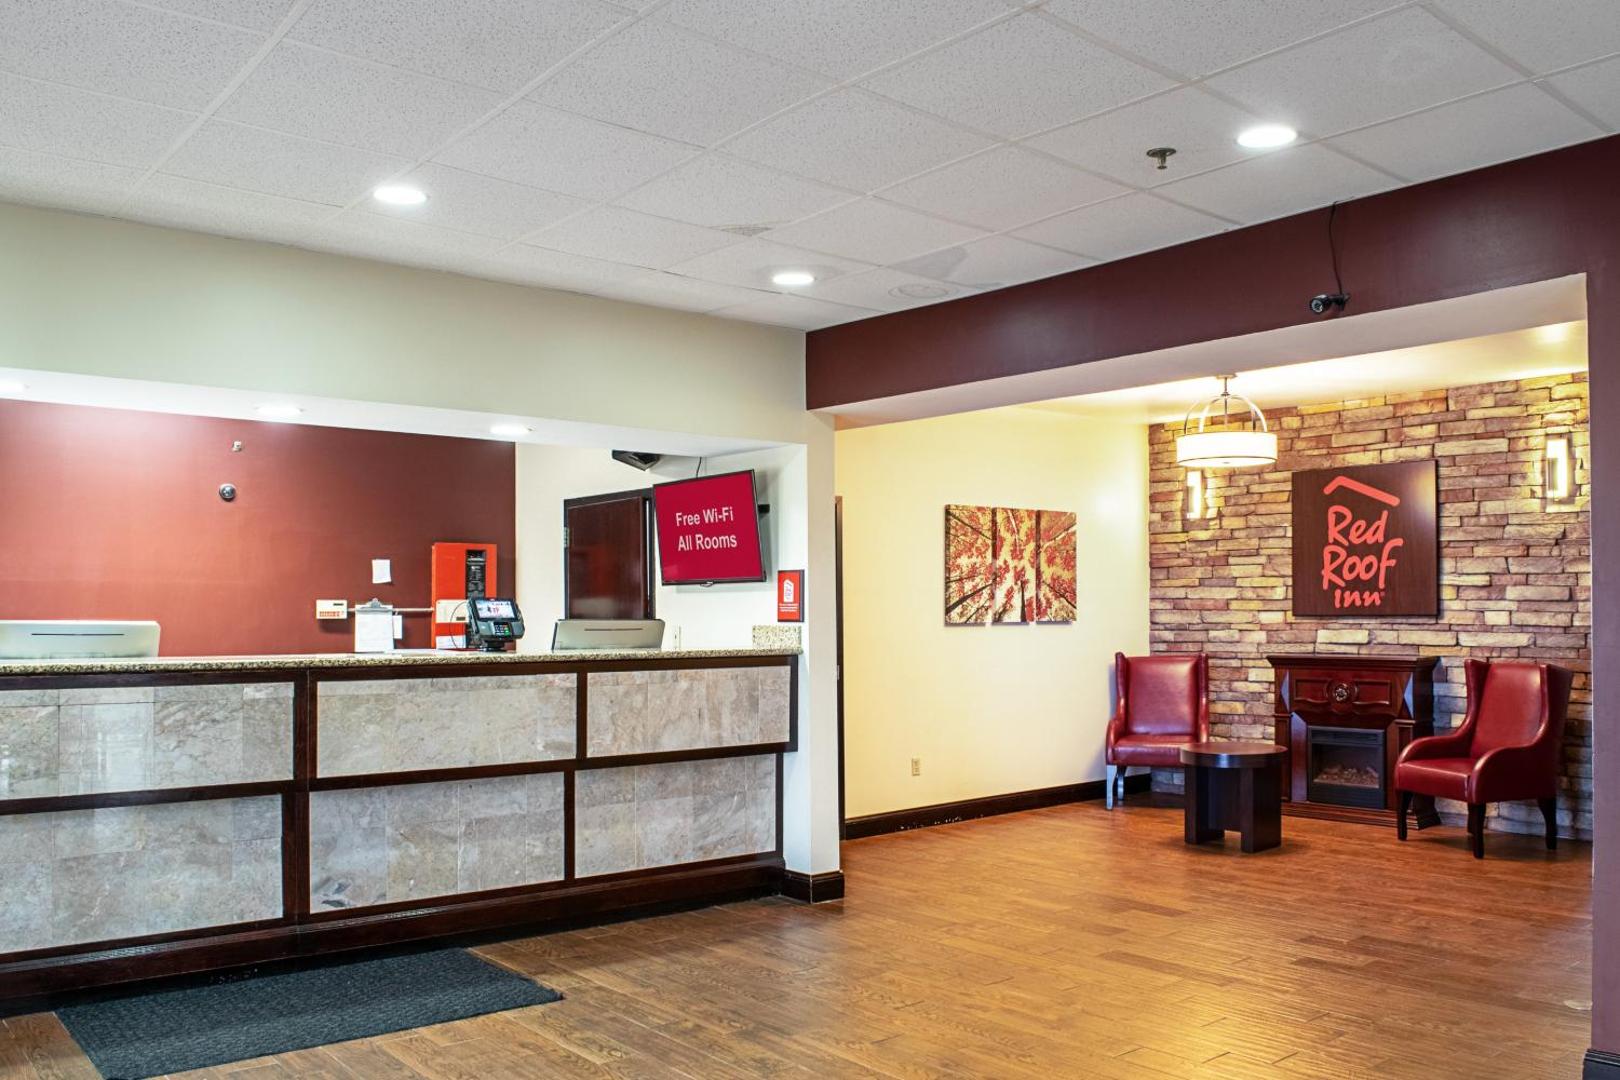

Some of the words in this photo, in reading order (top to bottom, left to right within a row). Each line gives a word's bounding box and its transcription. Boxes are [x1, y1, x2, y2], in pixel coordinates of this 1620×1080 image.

[675, 512, 700, 526] Free
[703, 506, 734, 523] Wi-Fi
[1328, 505, 1389, 546] Red
[678, 535, 693, 551] All
[695, 534, 738, 550] Rooms
[1322, 538, 1404, 590] Roof
